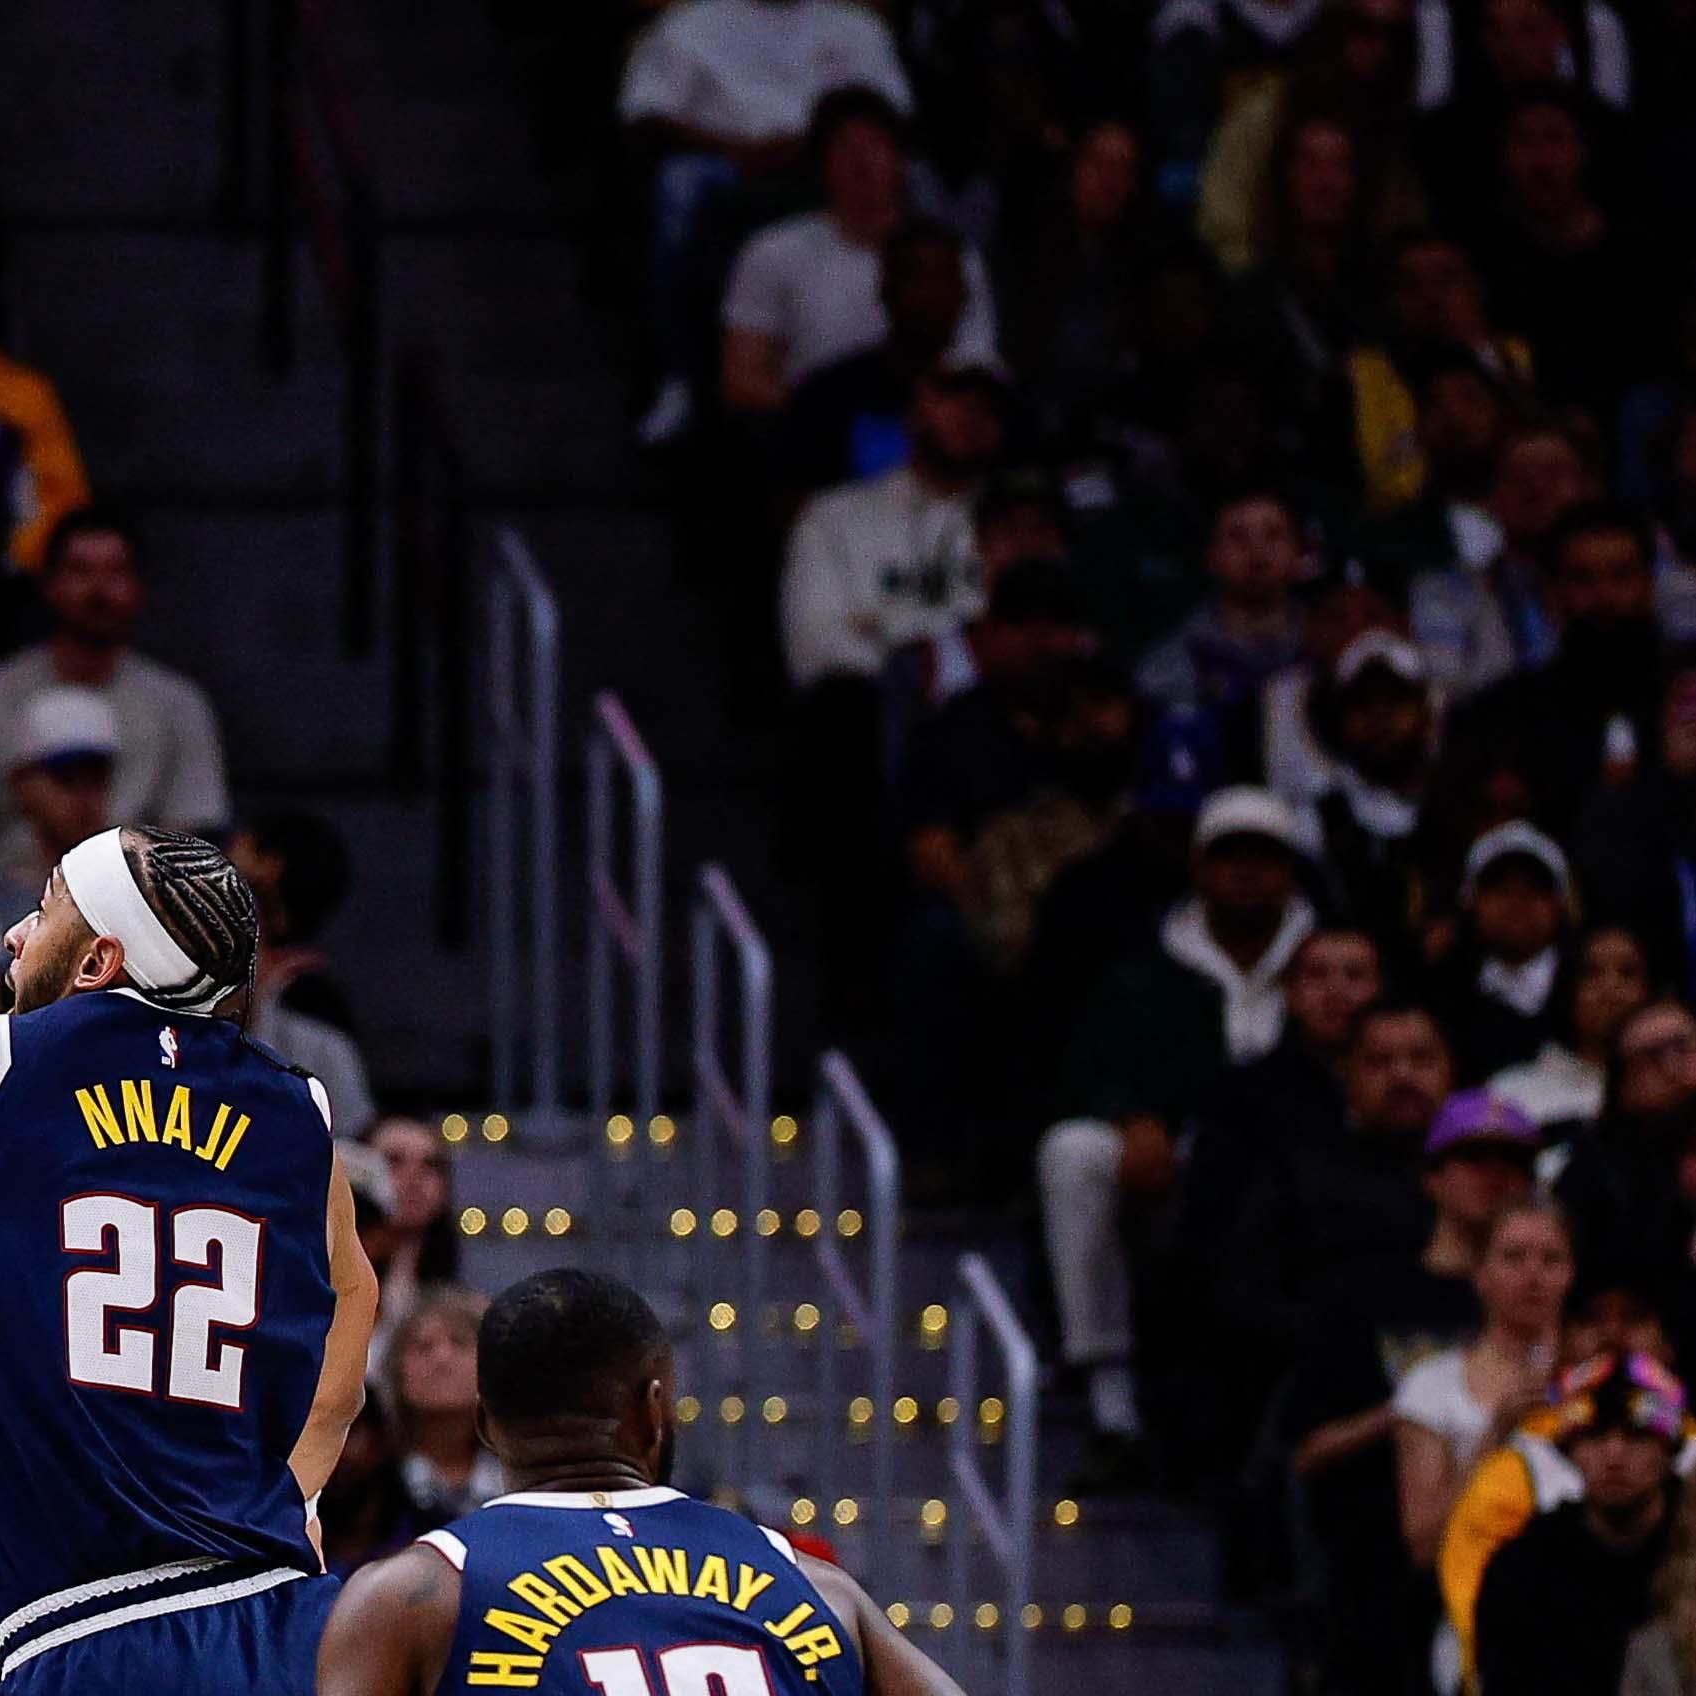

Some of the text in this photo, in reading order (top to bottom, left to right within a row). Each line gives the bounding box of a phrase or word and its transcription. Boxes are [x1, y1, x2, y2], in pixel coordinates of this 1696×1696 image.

[74, 1078, 251, 1172] NNAJI
[59, 1191, 266, 1412] 22
[466, 1544, 842, 1688] HARDAWAY JR.
